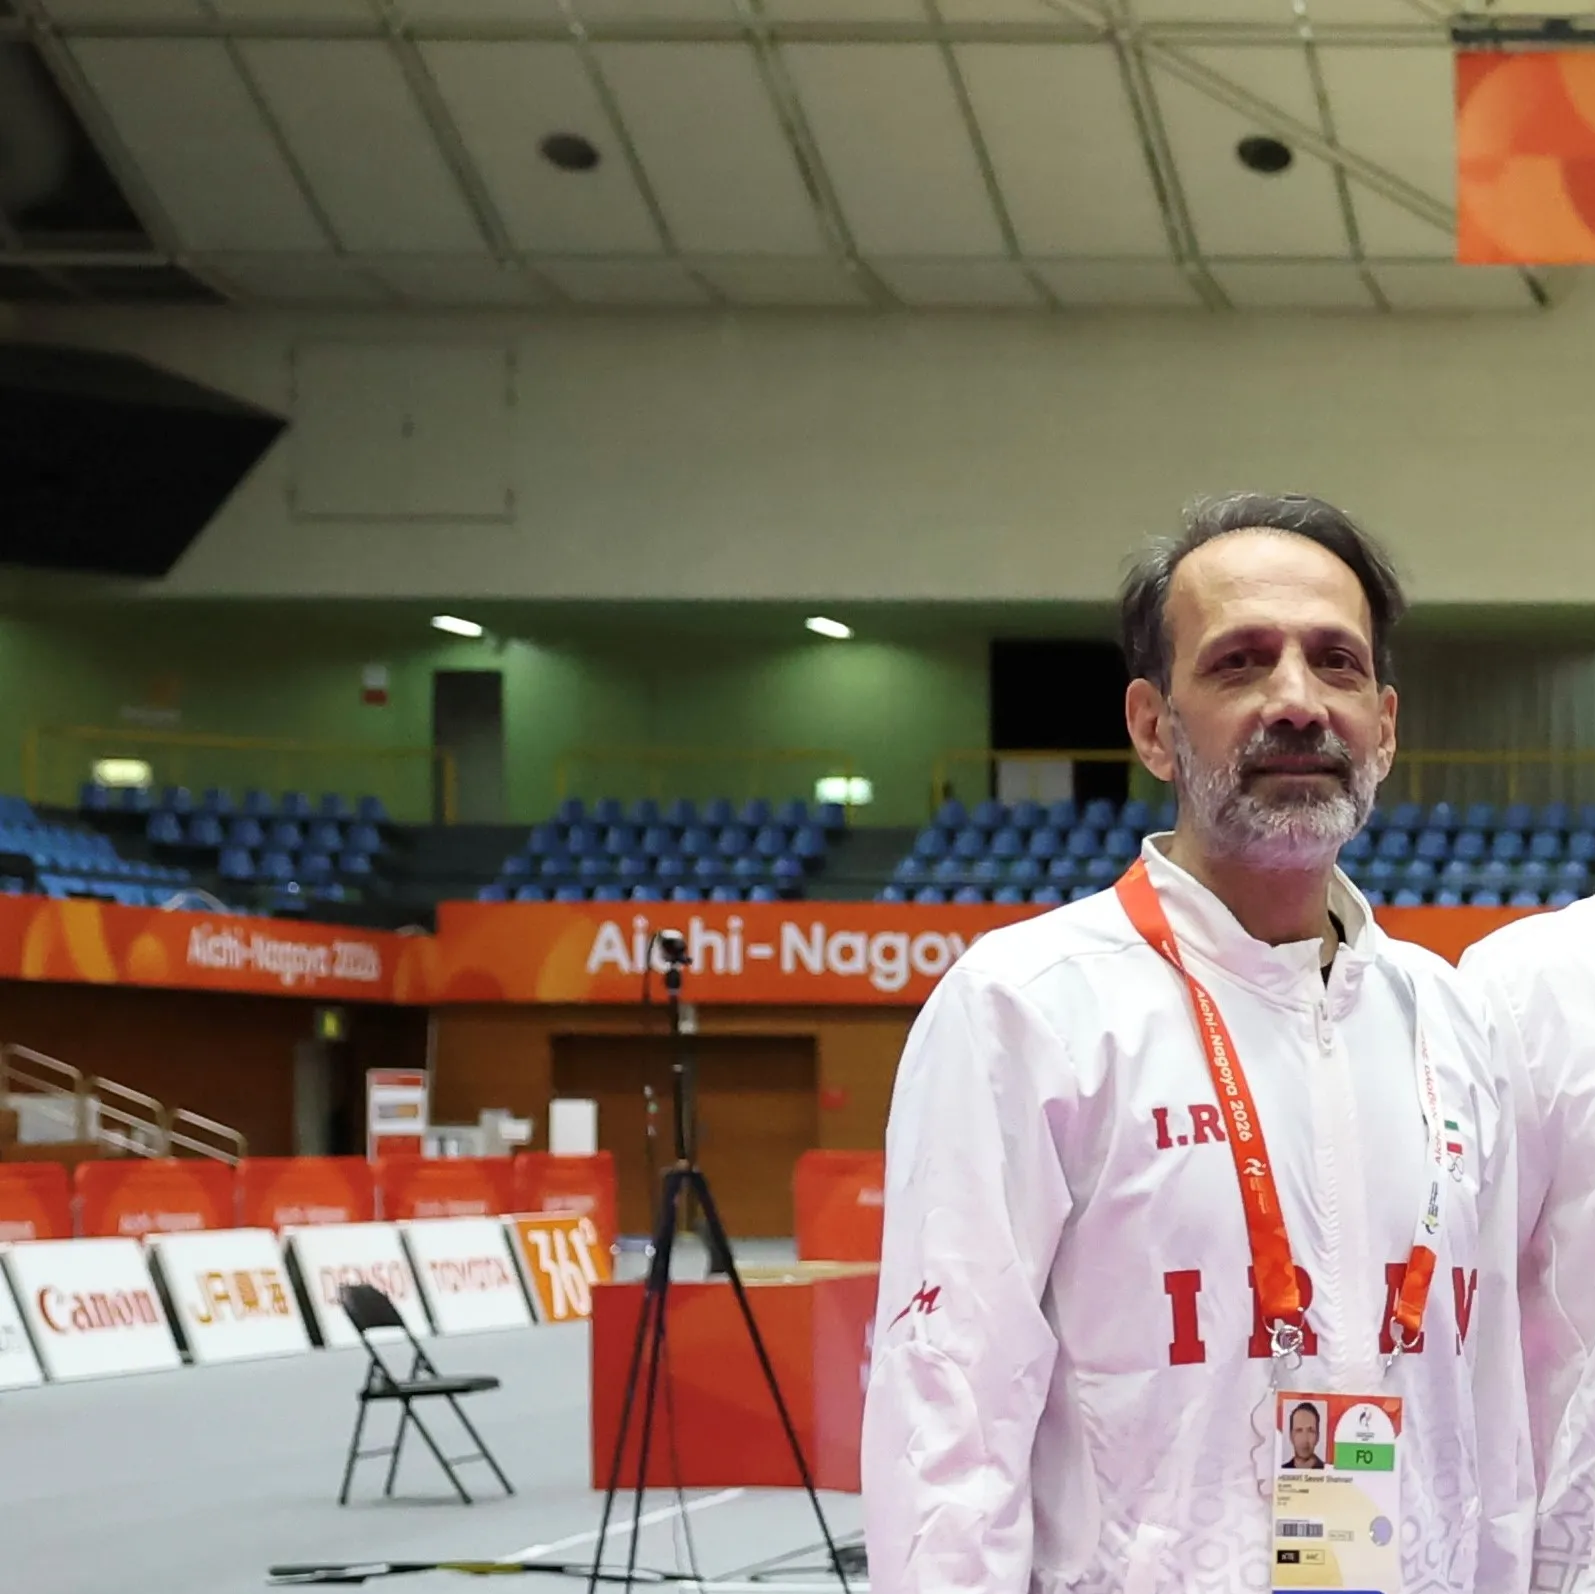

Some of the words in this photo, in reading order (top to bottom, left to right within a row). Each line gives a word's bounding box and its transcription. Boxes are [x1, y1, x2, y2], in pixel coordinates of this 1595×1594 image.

[1229, 1100, 1253, 1142] 2026
[36, 1284, 162, 1334] Canon
[1355, 1450, 1374, 1466] FO
